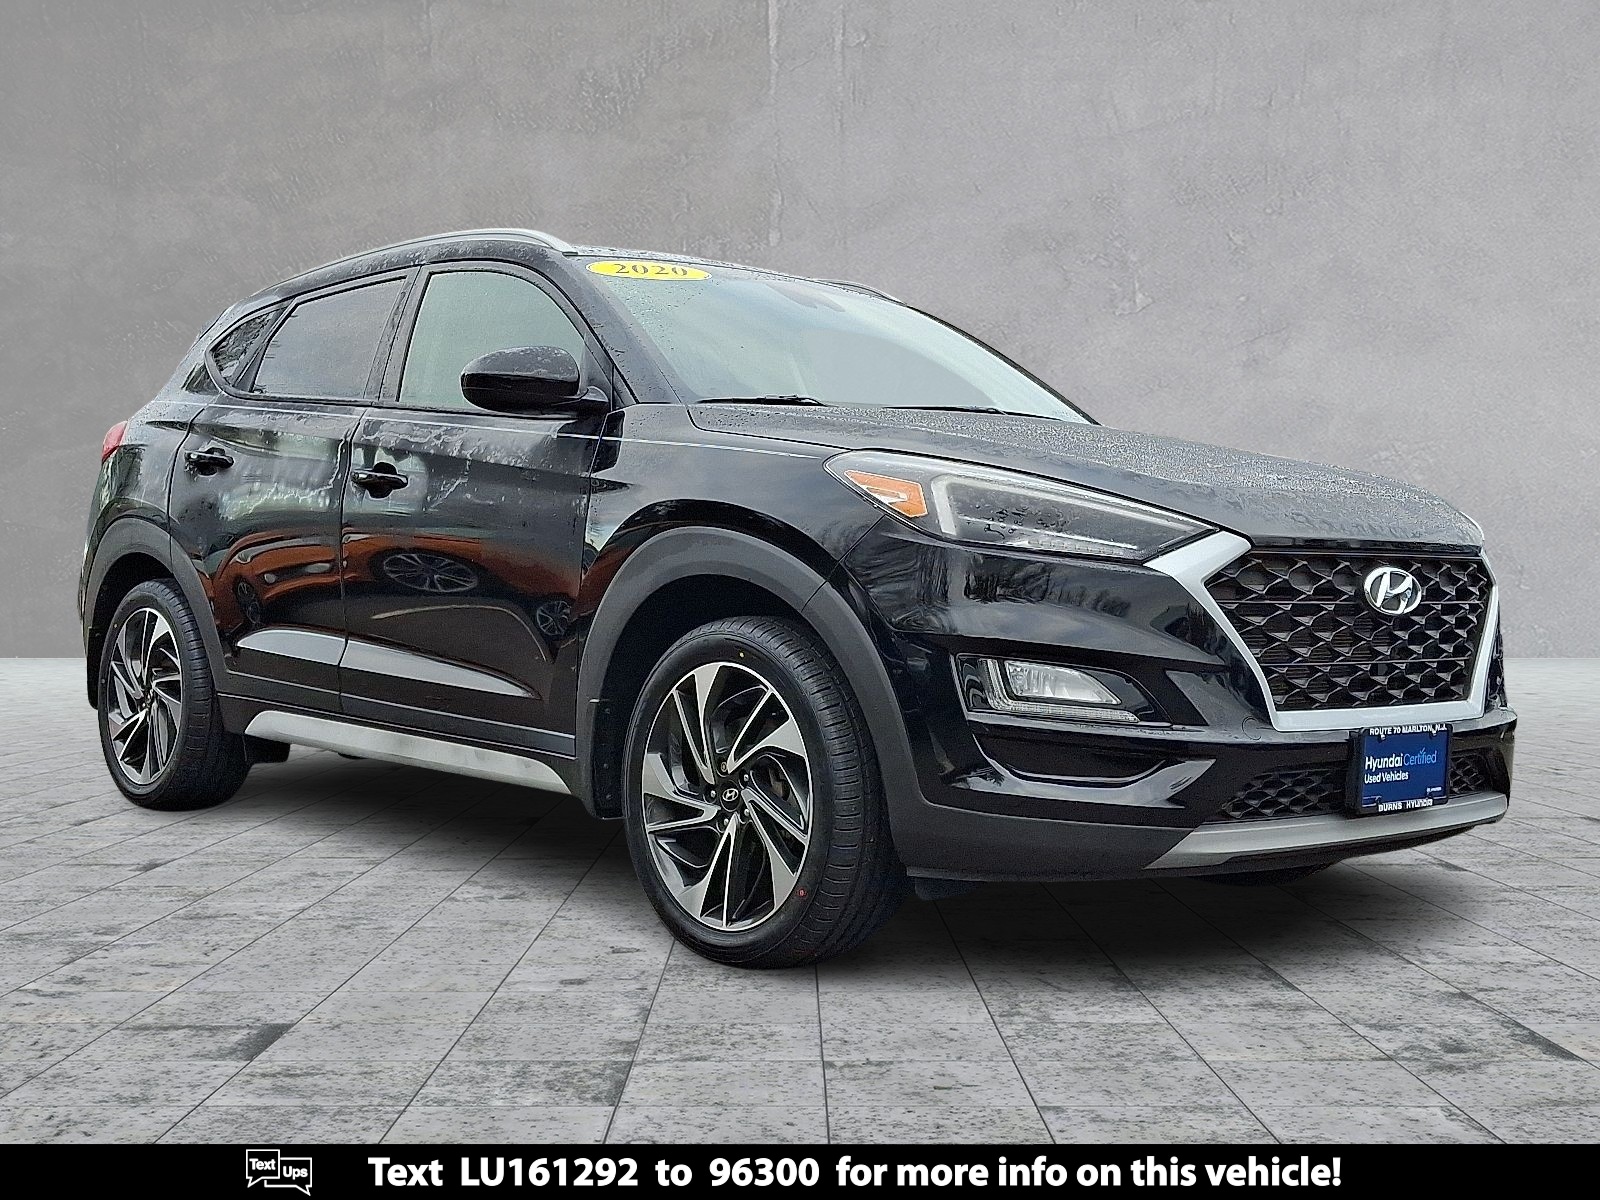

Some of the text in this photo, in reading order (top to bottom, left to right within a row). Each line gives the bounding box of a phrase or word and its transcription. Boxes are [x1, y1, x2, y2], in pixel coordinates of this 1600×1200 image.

[613, 263, 688, 277] 2020
[1369, 726, 1392, 736] ROUTE
[1393, 726, 1402, 735] 70
[1365, 749, 1438, 773] Hyundai Certified
[1364, 770, 1409, 784] Used Vehicles
